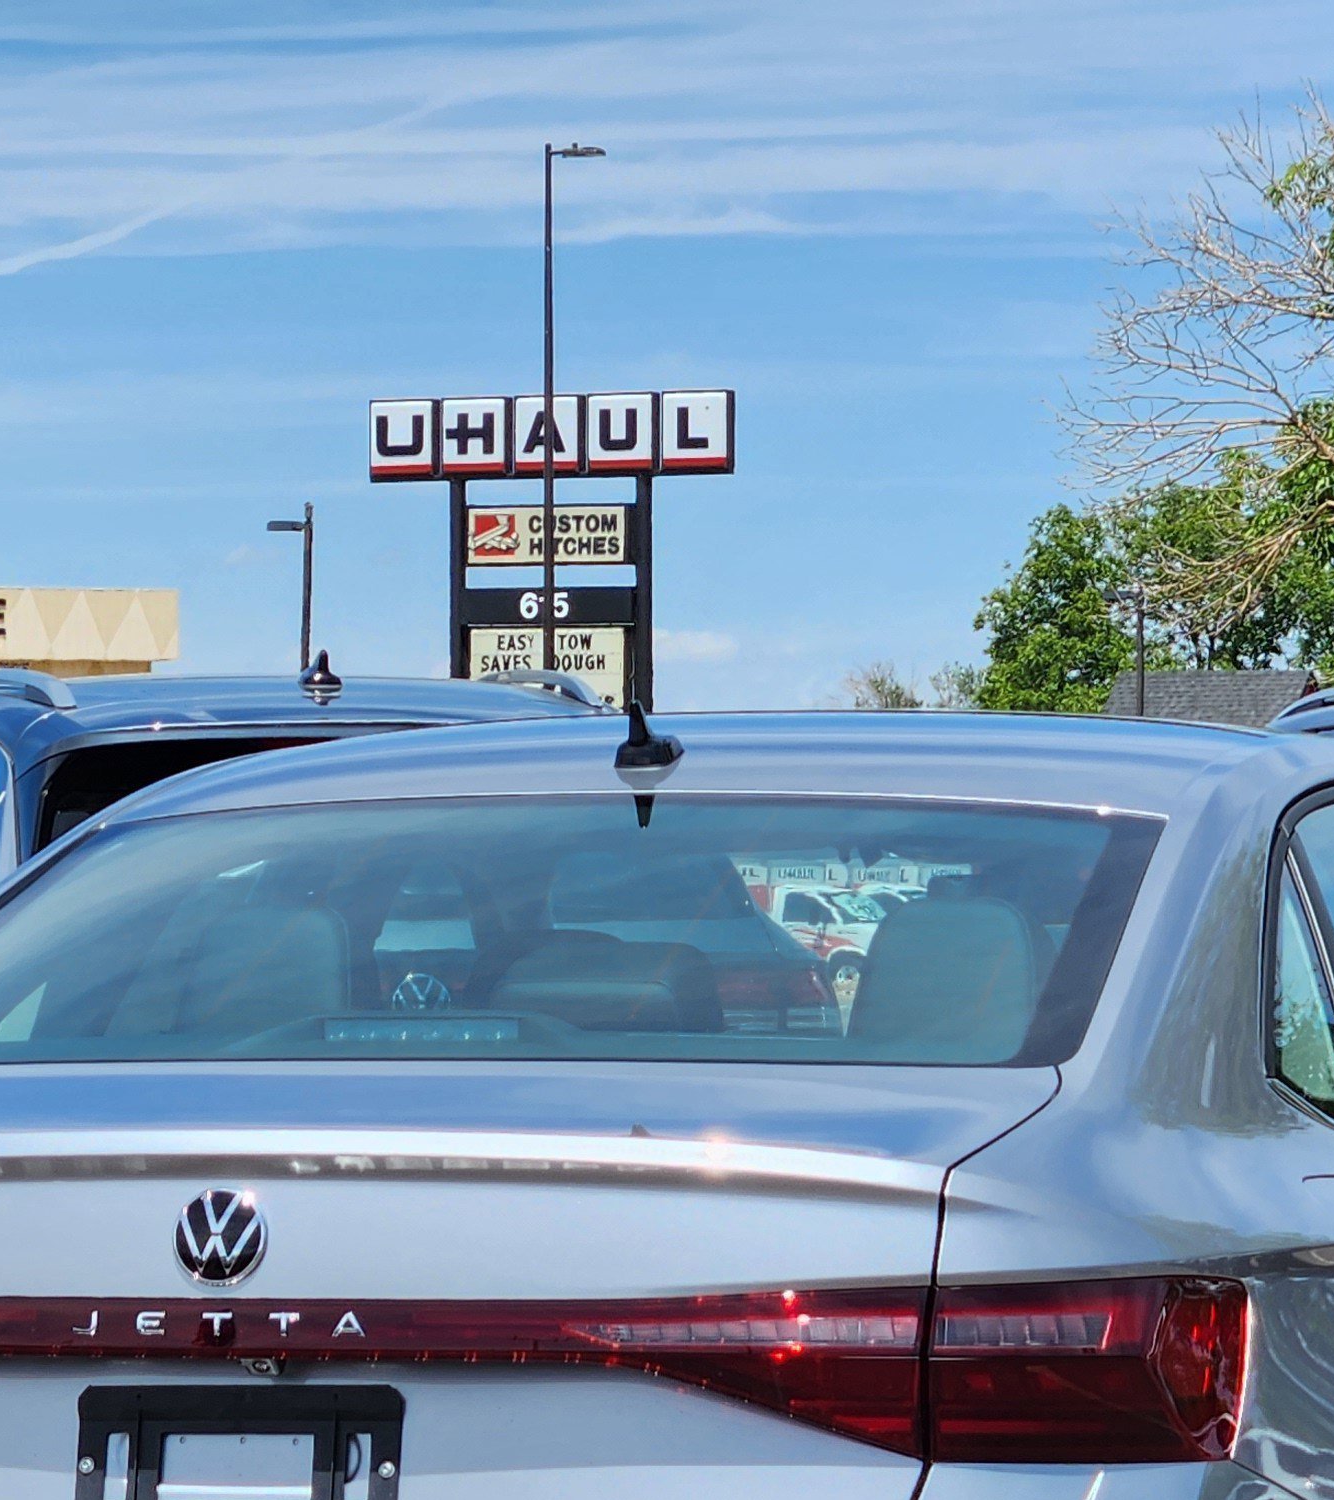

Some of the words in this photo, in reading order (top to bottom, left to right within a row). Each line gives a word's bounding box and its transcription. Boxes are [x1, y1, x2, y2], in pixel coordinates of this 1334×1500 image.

[528, 514, 617, 533] CSTOM
[529, 536, 620, 556] HTCHES
[497, 634, 534, 651] EASY
[557, 634, 593, 650] TOW
[480, 655, 532, 673] SAVES
[71, 1309, 366, 1338] JETTA
